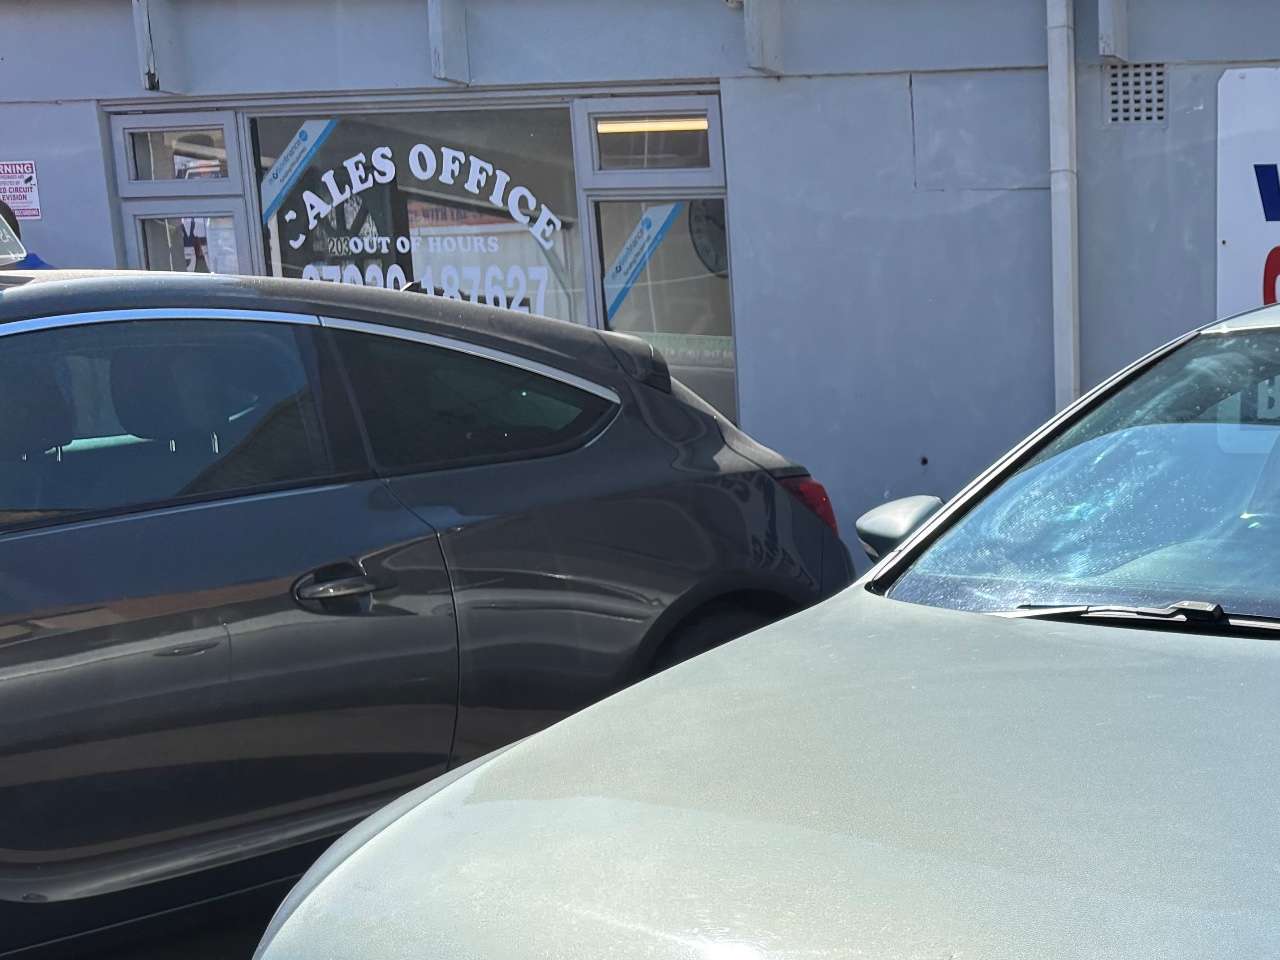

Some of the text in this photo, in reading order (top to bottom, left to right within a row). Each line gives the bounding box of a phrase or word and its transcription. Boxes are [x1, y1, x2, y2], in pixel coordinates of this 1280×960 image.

[409, 143, 562, 250] OFFICE
[349, 236, 499, 253] OUT OF HOURS
